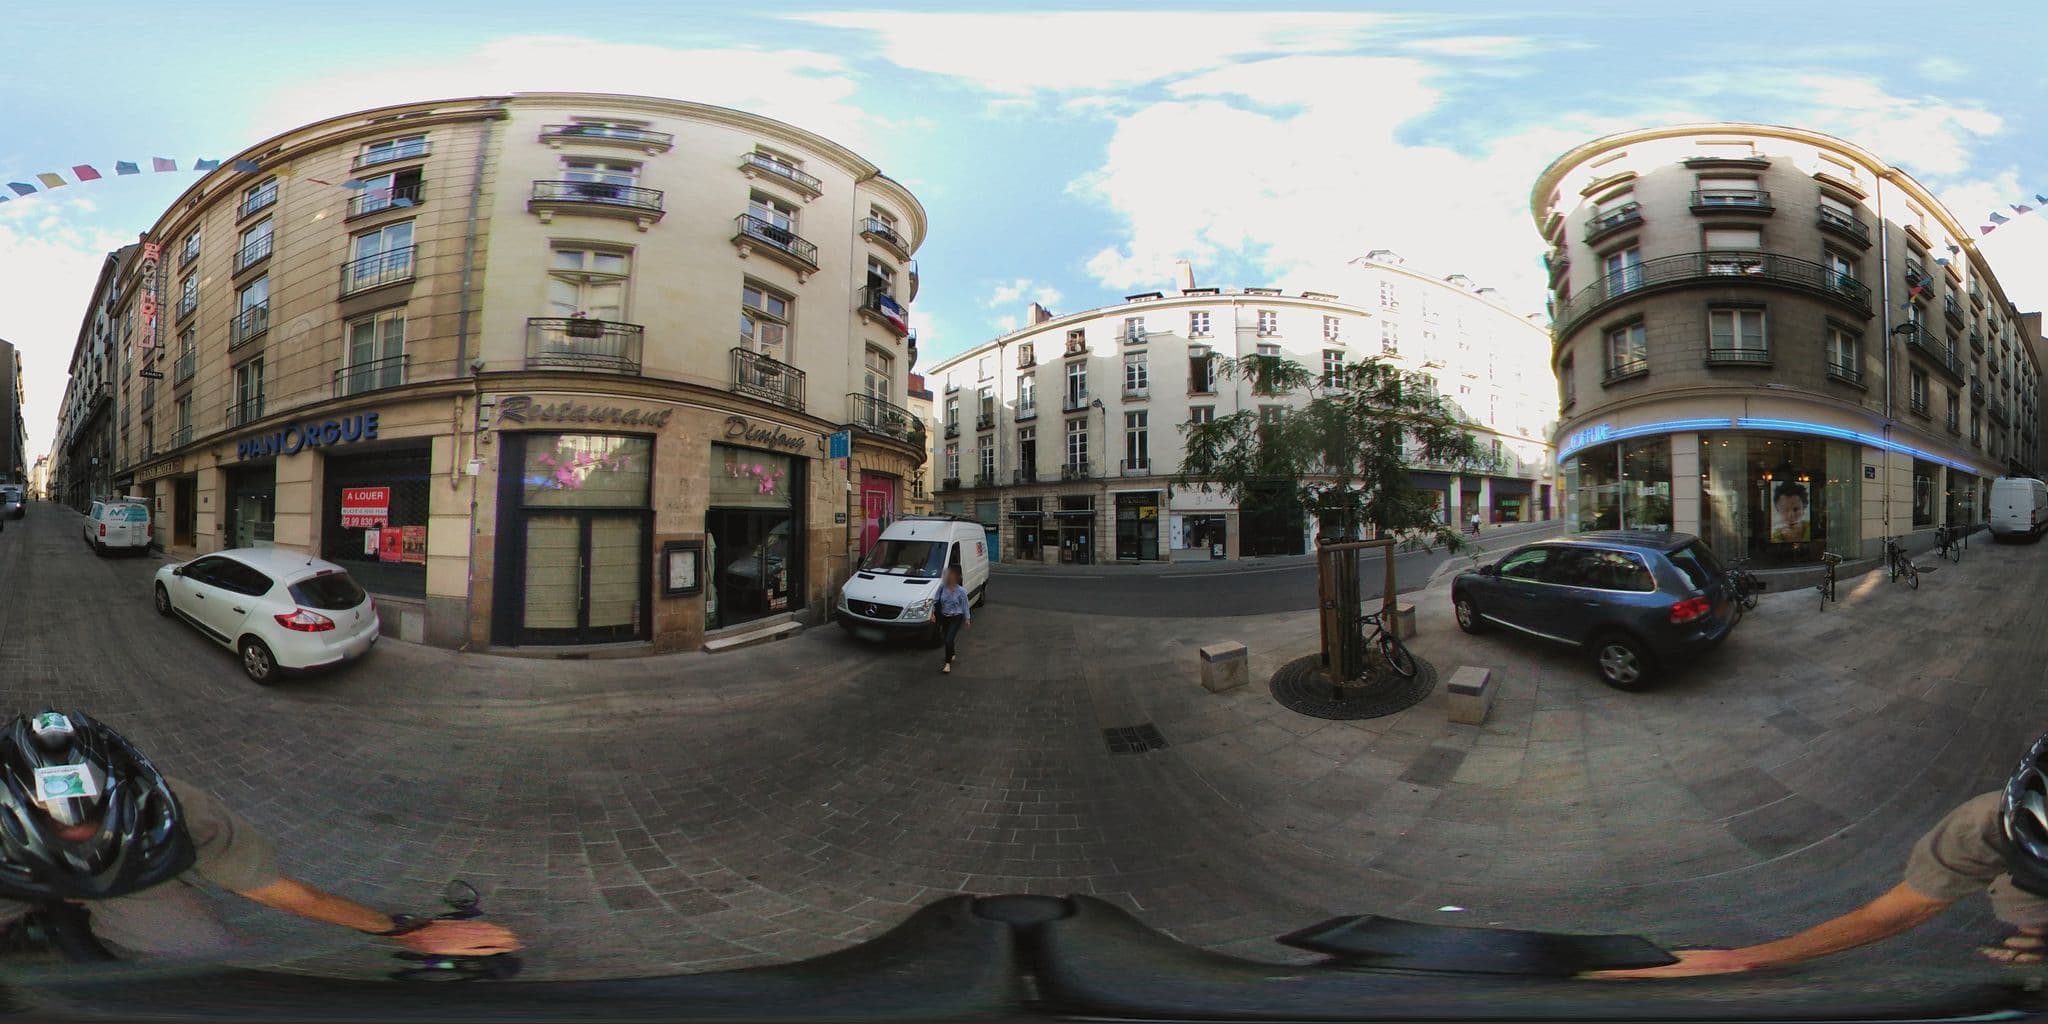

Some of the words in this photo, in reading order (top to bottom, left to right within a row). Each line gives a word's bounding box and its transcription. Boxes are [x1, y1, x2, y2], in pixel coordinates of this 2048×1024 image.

[497, 395, 673, 429] Restaurant
[237, 411, 379, 460] PIANORGUE
[347, 492, 353, 500] A
[354, 491, 384, 500] LOUER
